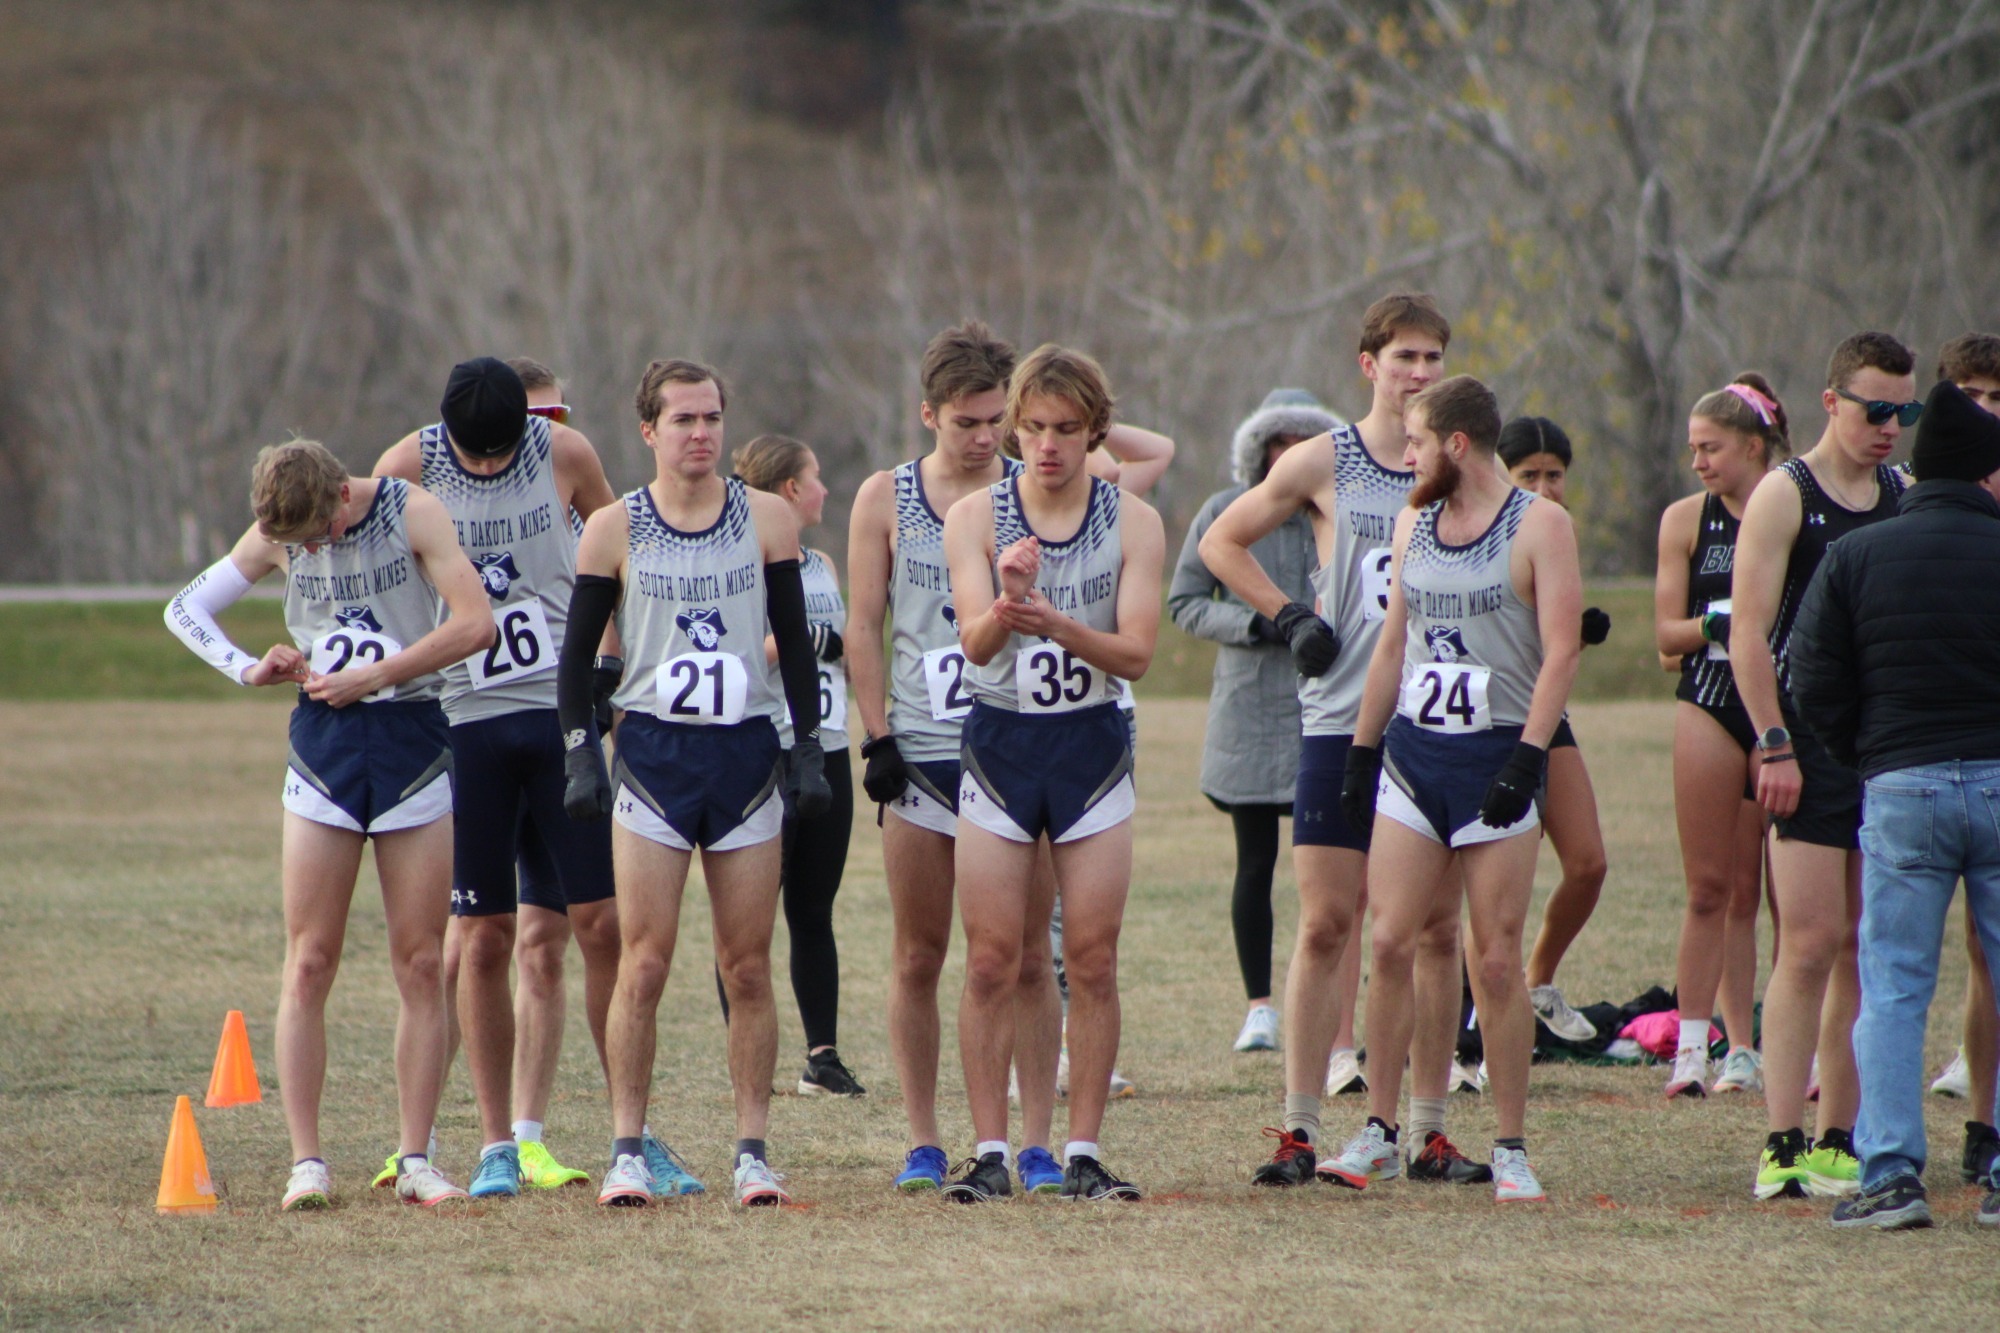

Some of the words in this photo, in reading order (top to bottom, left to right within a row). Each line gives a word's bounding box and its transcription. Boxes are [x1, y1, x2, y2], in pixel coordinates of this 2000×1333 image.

[471, 518, 513, 547] DAKOTA
[519, 503, 551, 541] MINES
[1350, 510, 1385, 541] SOUTH
[296, 574, 330, 601] SOUTH
[331, 571, 370, 601] DAKOTA
[373, 556, 407, 594] MINES
[639, 570, 674, 601] SOUTH
[679, 574, 720, 602] DAKOTA
[725, 563, 755, 597] MINES
[907, 558, 941, 591] SOUTH
[1081, 571, 1111, 605] MINES
[1426, 591, 1463, 619] DAKOTA
[1469, 583, 1502, 617] MINES
[179, 614, 196, 630] OF
[190, 626, 215, 648] ONE
[483, 610, 540, 678] 26
[670, 659, 723, 716] 21
[1030, 650, 1092, 707] 35
[1418, 670, 1475, 725] 24
